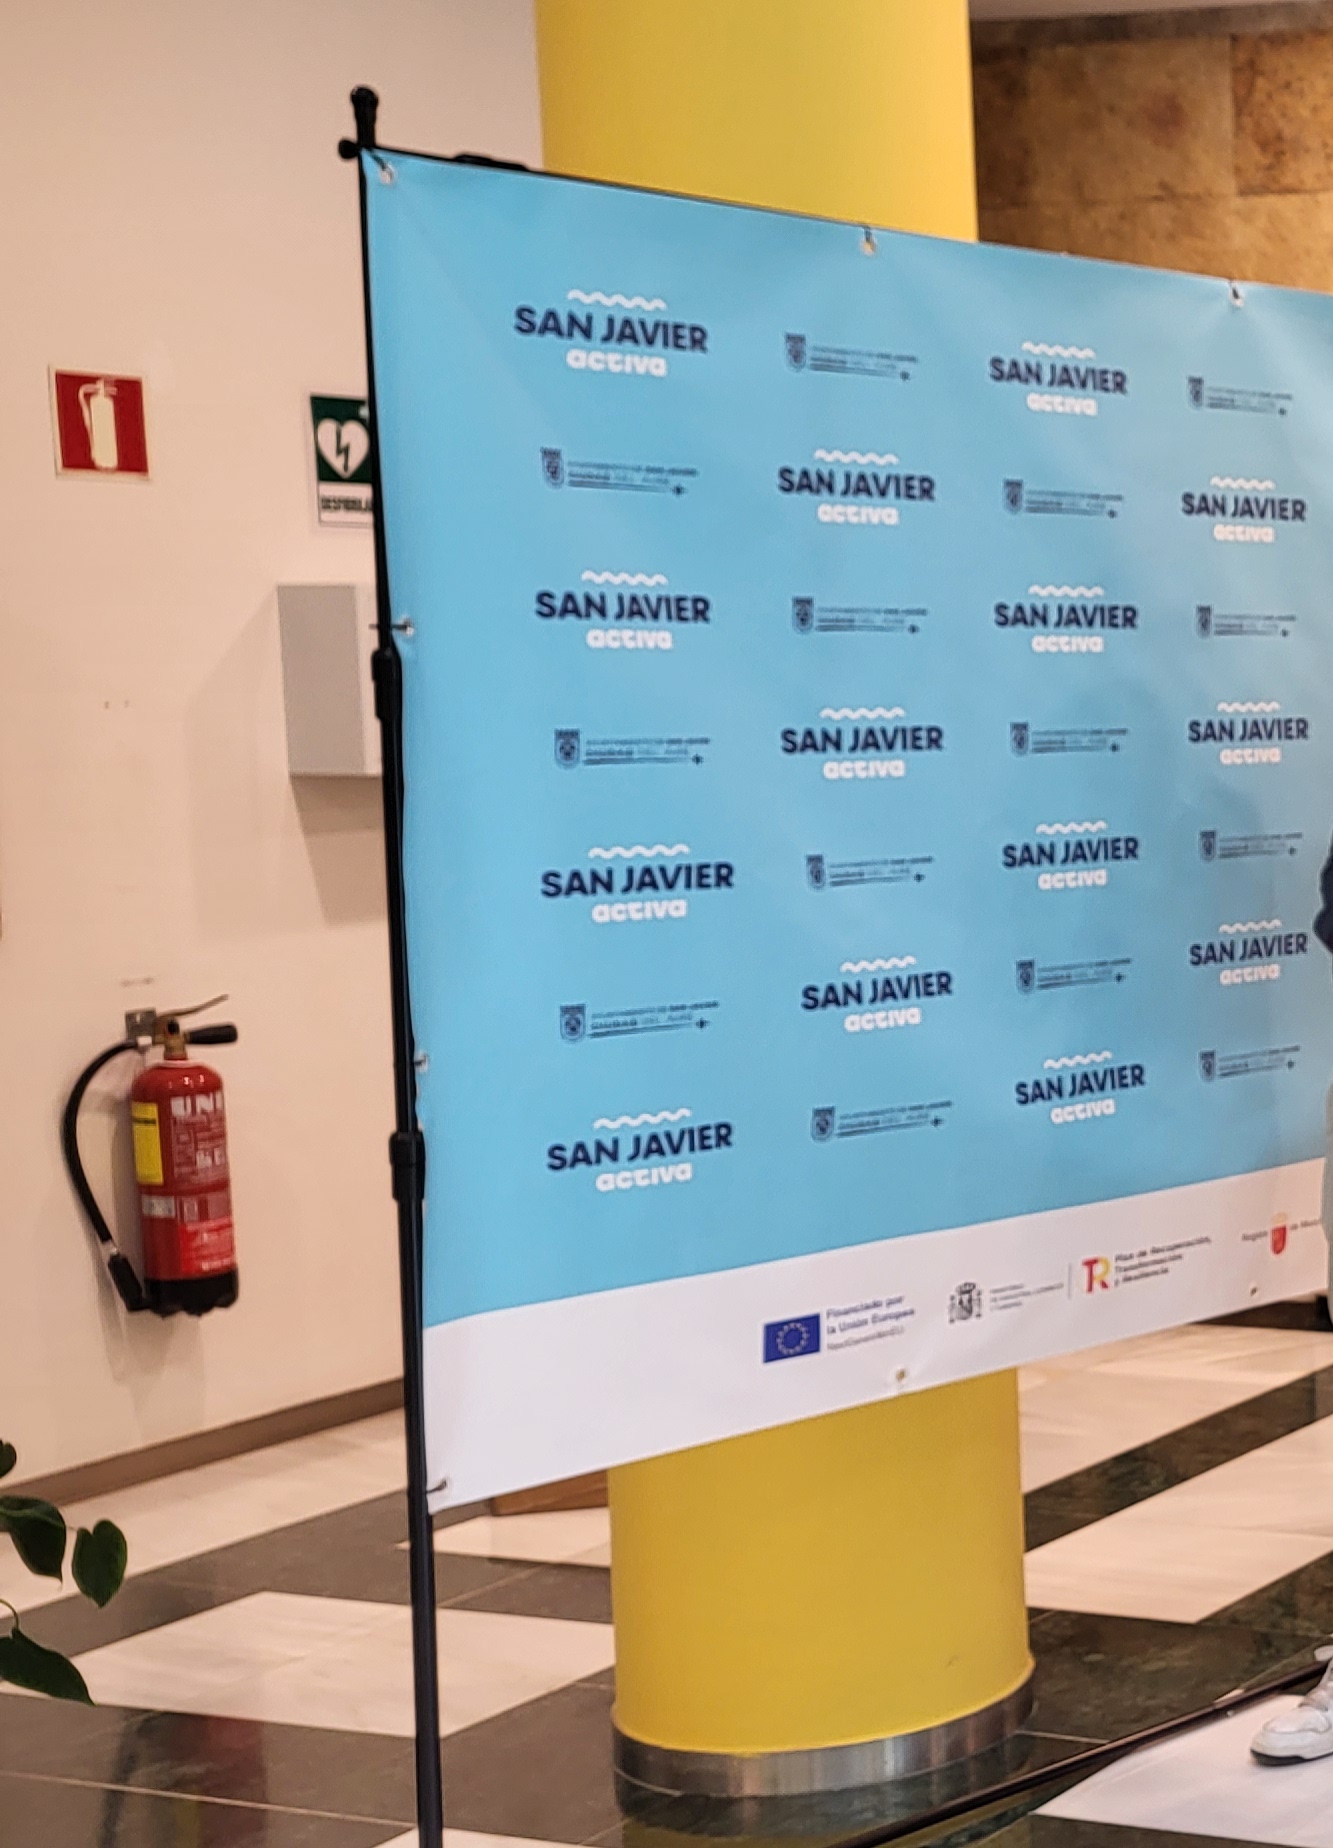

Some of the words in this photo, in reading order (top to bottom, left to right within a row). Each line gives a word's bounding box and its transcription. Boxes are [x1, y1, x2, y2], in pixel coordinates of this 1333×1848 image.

[513, 306, 594, 342] SAN
[600, 315, 708, 353] JAVIER
[989, 356, 1043, 386] SAN
[1047, 363, 1127, 395] JAVIER
[777, 466, 836, 496] SAN
[840, 471, 935, 502] JAVIER
[1181, 492, 1227, 517] SAN
[1231, 496, 1307, 522] JAVIER
[535, 590, 608, 621] SAN
[613, 593, 711, 624] JAVIER
[994, 602, 1049, 628] SAN
[1053, 604, 1139, 630] JAVIER
[780, 727, 843, 755] SAN
[847, 725, 944, 754] JAVIER
[1188, 719, 1235, 744] SAN
[1239, 717, 1309, 743] JAVIER
[1002, 841, 1056, 869] SAN
[1060, 836, 1139, 865] JAVIER
[541, 867, 614, 899] SAN
[620, 861, 735, 895] JAVIER
[1189, 939, 1235, 967] SAN
[1239, 932, 1309, 961] JAVIER
[800, 979, 864, 1011] SAN
[868, 970, 953, 1005] JAVIER
[1015, 1075, 1064, 1106] SAN
[1068, 1063, 1145, 1099] JAVIER
[547, 1137, 620, 1172] SAN
[627, 1121, 733, 1162] JAVIER
